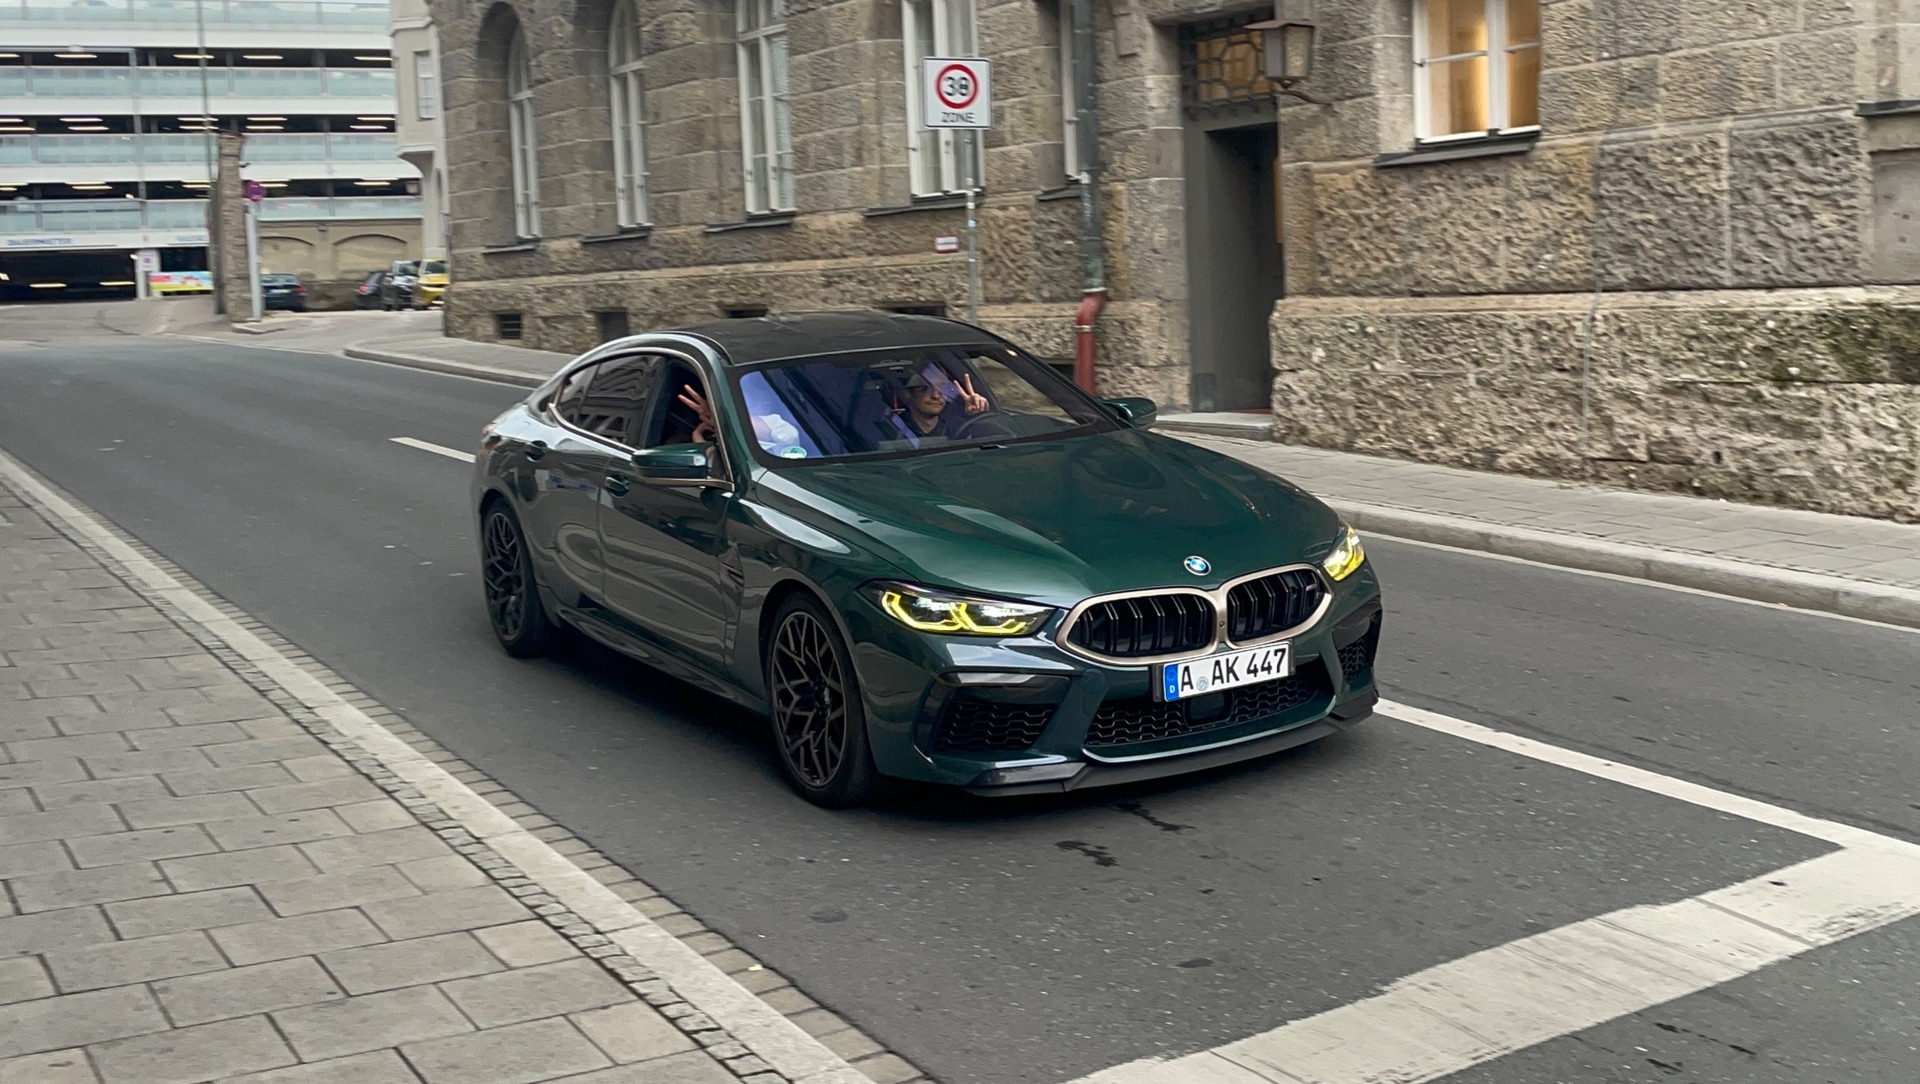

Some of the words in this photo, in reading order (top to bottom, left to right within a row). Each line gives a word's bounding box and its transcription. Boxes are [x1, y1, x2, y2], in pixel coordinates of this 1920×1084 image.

[941, 112, 976, 124] ZONE
[1180, 665, 1194, 692] A
[1211, 656, 1240, 686] AK
[1246, 647, 1287, 678] 447
[1169, 685, 1176, 694] D
